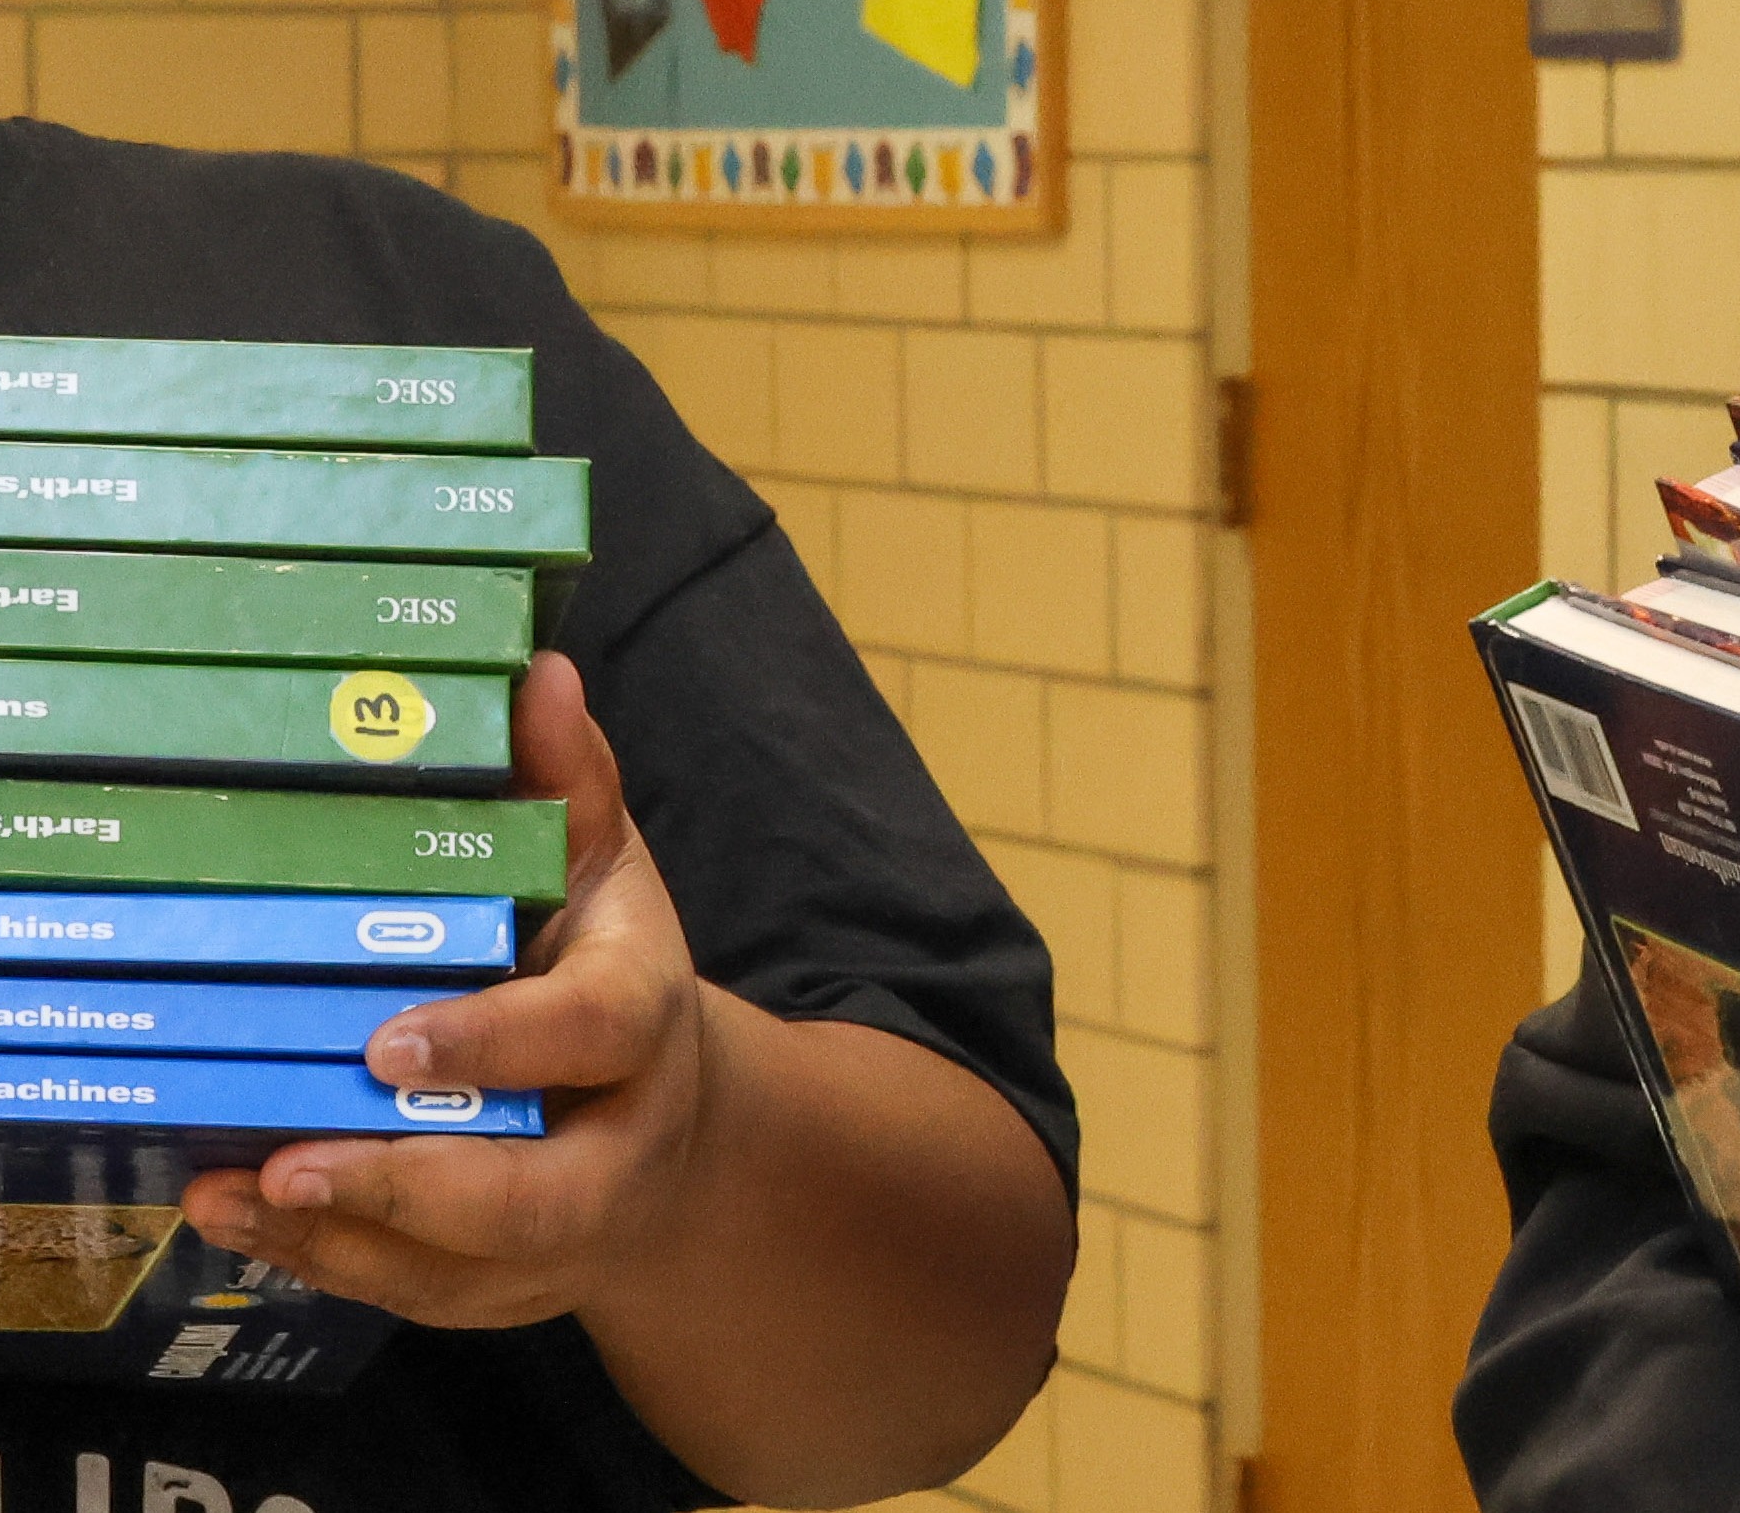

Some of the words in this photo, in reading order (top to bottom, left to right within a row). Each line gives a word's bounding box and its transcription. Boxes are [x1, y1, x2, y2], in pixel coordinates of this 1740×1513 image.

[376, 378, 457, 406] SSEC
[435, 487, 515, 513] SSEC
[377, 597, 457, 625] SSEC
[354, 693, 399, 736] 13
[414, 830, 493, 858] SSEC
